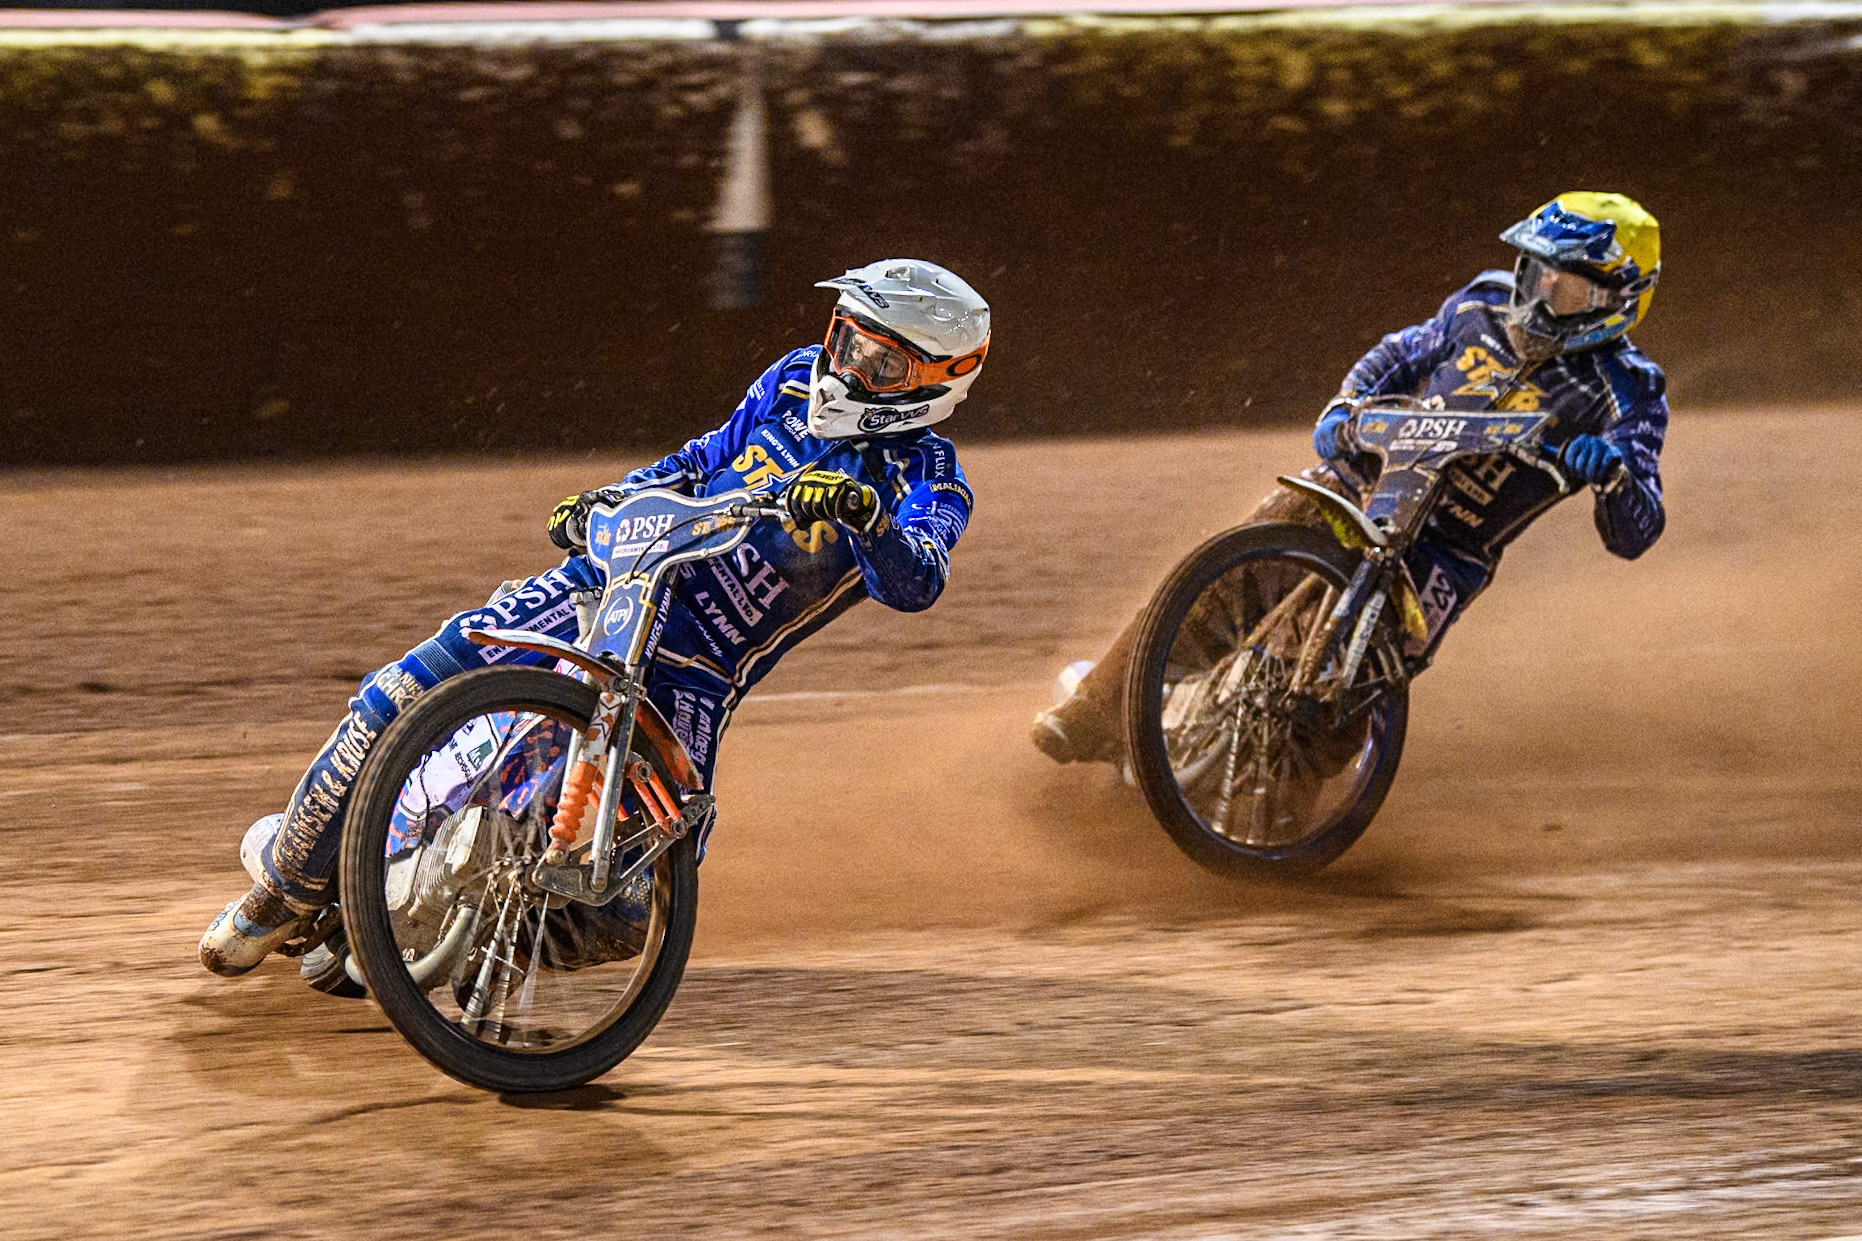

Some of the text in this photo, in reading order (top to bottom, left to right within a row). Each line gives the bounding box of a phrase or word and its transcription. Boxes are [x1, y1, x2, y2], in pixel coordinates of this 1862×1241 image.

[1416, 419, 1466, 441] PSH
[629, 514, 675, 541] PSH
[734, 542, 790, 609] SH
[492, 570, 575, 626] PSH
[695, 591, 747, 646] LYNN
[320, 769, 346, 797] &
